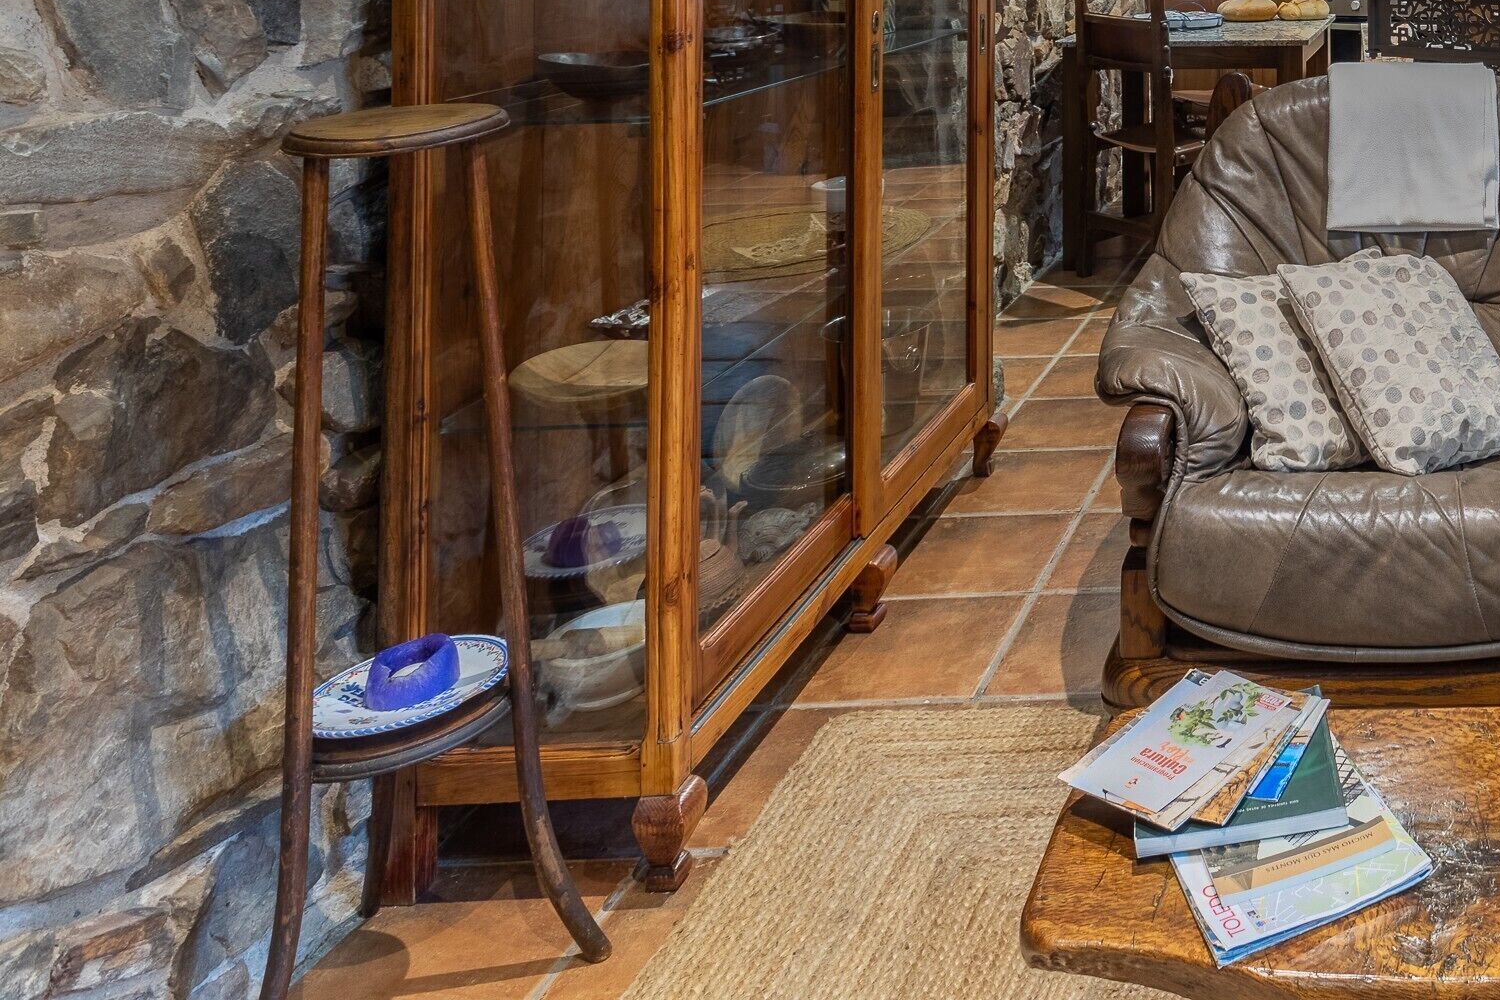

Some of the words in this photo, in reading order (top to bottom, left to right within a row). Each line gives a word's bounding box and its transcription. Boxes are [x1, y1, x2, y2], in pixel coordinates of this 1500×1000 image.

[1140, 747, 1187, 775] Cultura
[1342, 831, 1375, 847] MUCHO
[1202, 884, 1245, 938] TOLEDO
